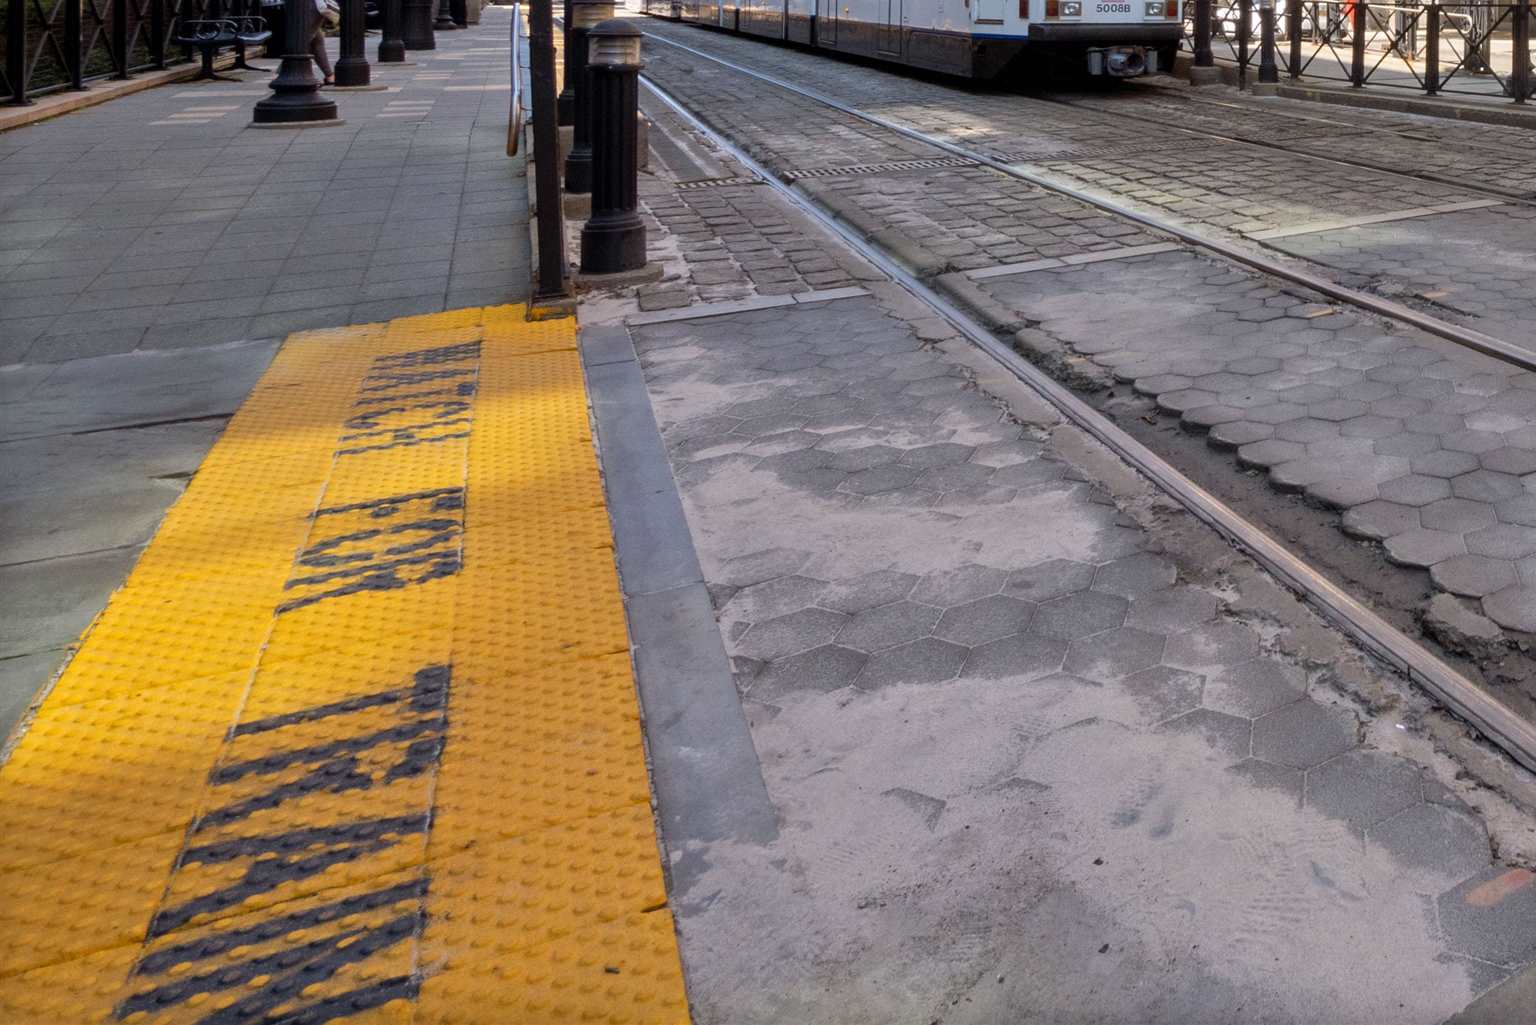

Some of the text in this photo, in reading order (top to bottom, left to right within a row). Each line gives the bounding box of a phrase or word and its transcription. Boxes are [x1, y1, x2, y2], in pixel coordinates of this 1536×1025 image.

[1096, 3, 1131, 13] 5008B
[112, 340, 481, 1025] WATCH FOR TRAIN
